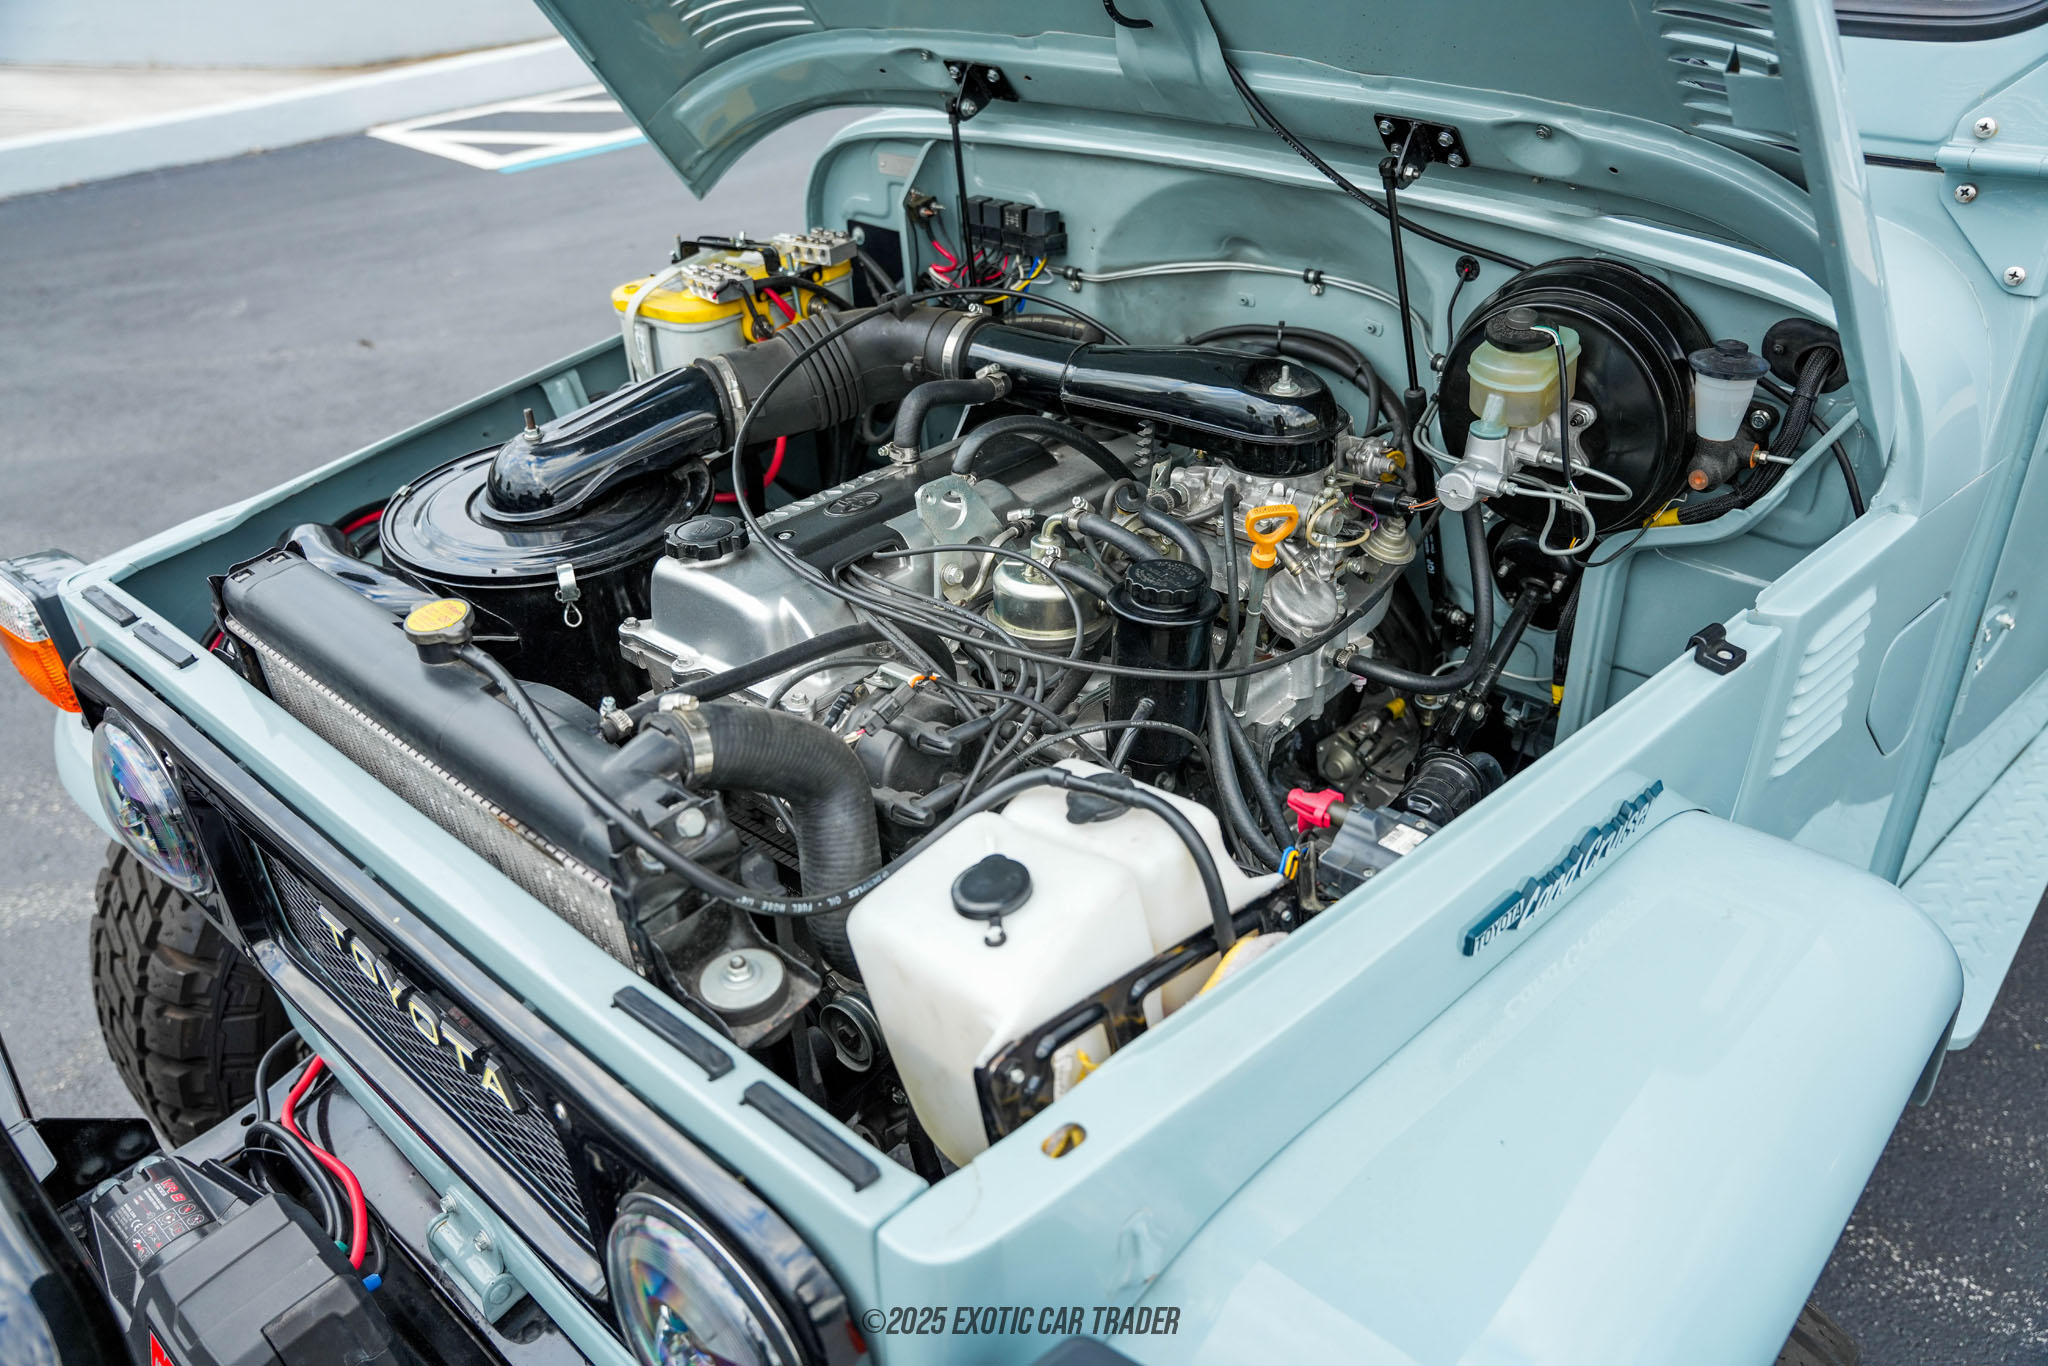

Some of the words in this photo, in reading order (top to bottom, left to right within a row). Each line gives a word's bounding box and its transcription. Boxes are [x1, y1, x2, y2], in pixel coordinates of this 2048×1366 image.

[761, 900, 786, 913] HOSE
[791, 902, 813, 913] FUEL
[826, 895, 842, 907] OIL
[1469, 897, 1525, 957] TOYOTA
[318, 903, 516, 1114] TOYOTA
